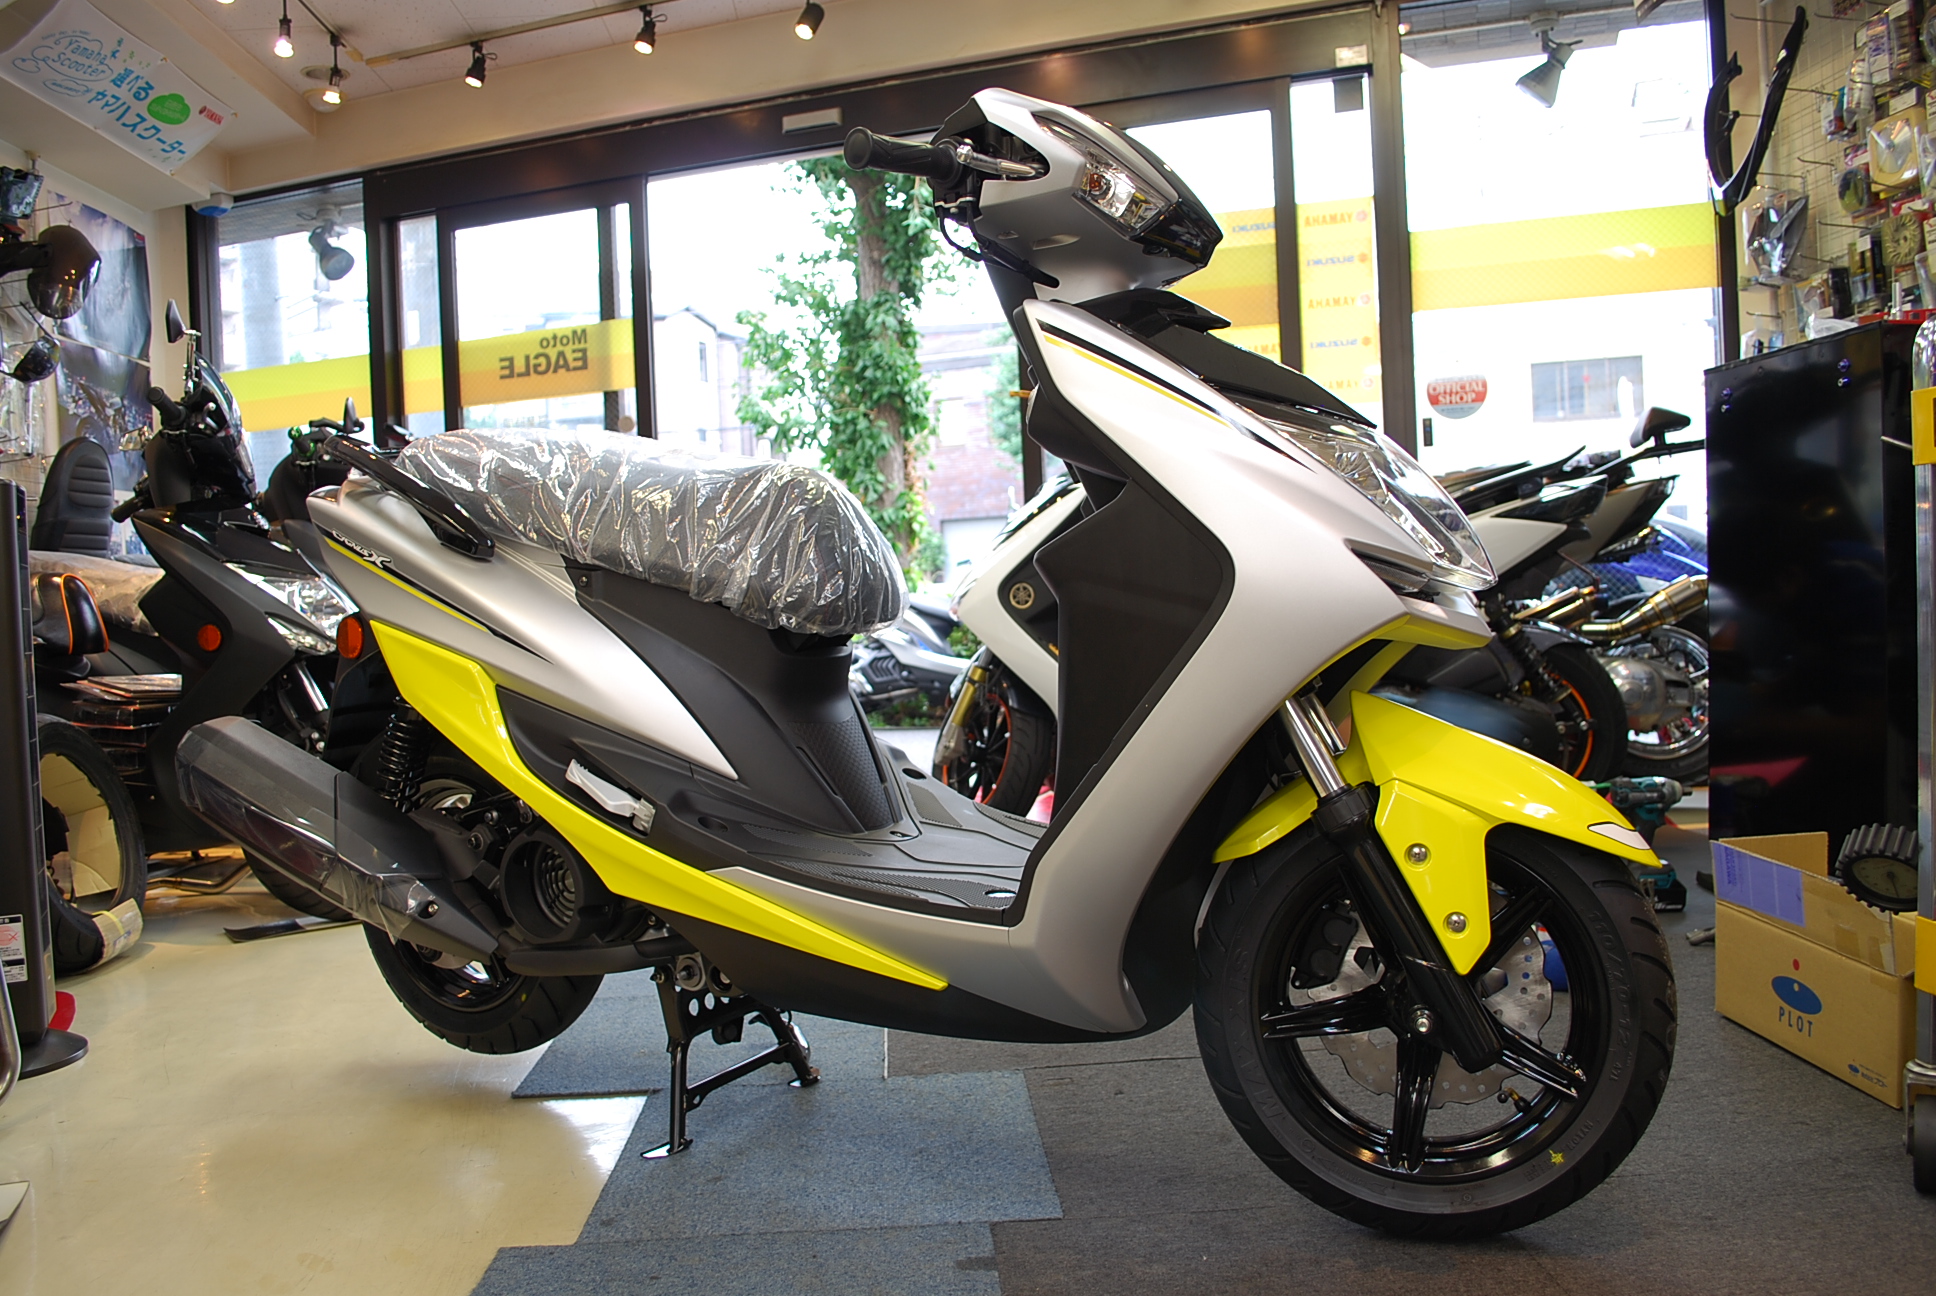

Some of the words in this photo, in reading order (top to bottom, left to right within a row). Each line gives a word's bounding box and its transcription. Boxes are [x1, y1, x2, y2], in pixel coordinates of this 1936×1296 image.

[51, 52, 107, 78] Scooter
[64, 38, 108, 66] Yamaha
[109, 67, 155, 102] 選べる
[87, 89, 187, 155] ヤマハスクーター
[1429, 381, 1485, 395] OFFICIAL
[1438, 392, 1476, 405] SHOP
[1779, 1005, 1813, 1038] PLOT
